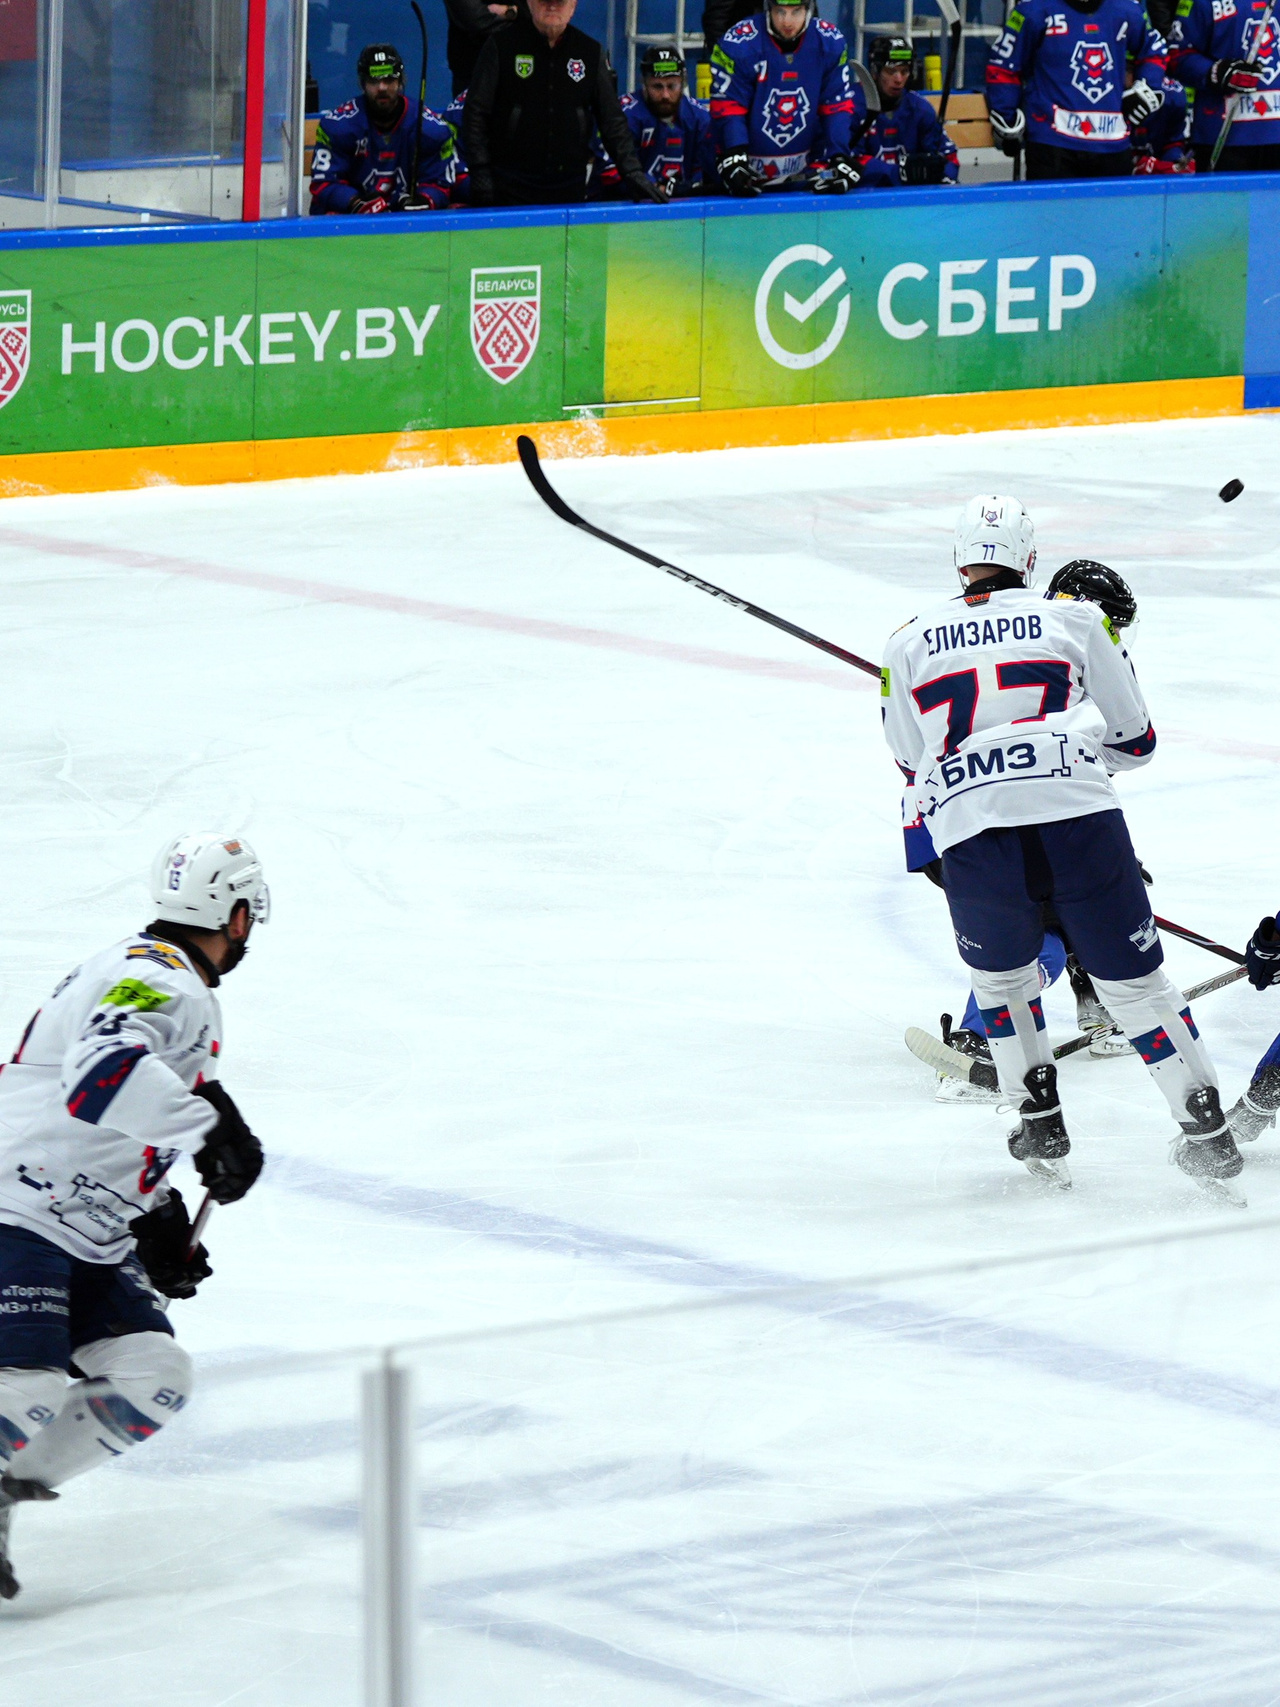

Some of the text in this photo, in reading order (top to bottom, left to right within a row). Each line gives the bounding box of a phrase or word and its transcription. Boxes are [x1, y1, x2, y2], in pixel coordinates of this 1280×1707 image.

[477, 279, 535, 292] БЕЛАРУСЬ
[877, 254, 1097, 340] СБЕР
[61, 304, 441, 374] HOCKEY.BY
[982, 544, 996, 560] 77
[911, 660, 1073, 763] 77
[941, 743, 1037, 789] БМЗ
